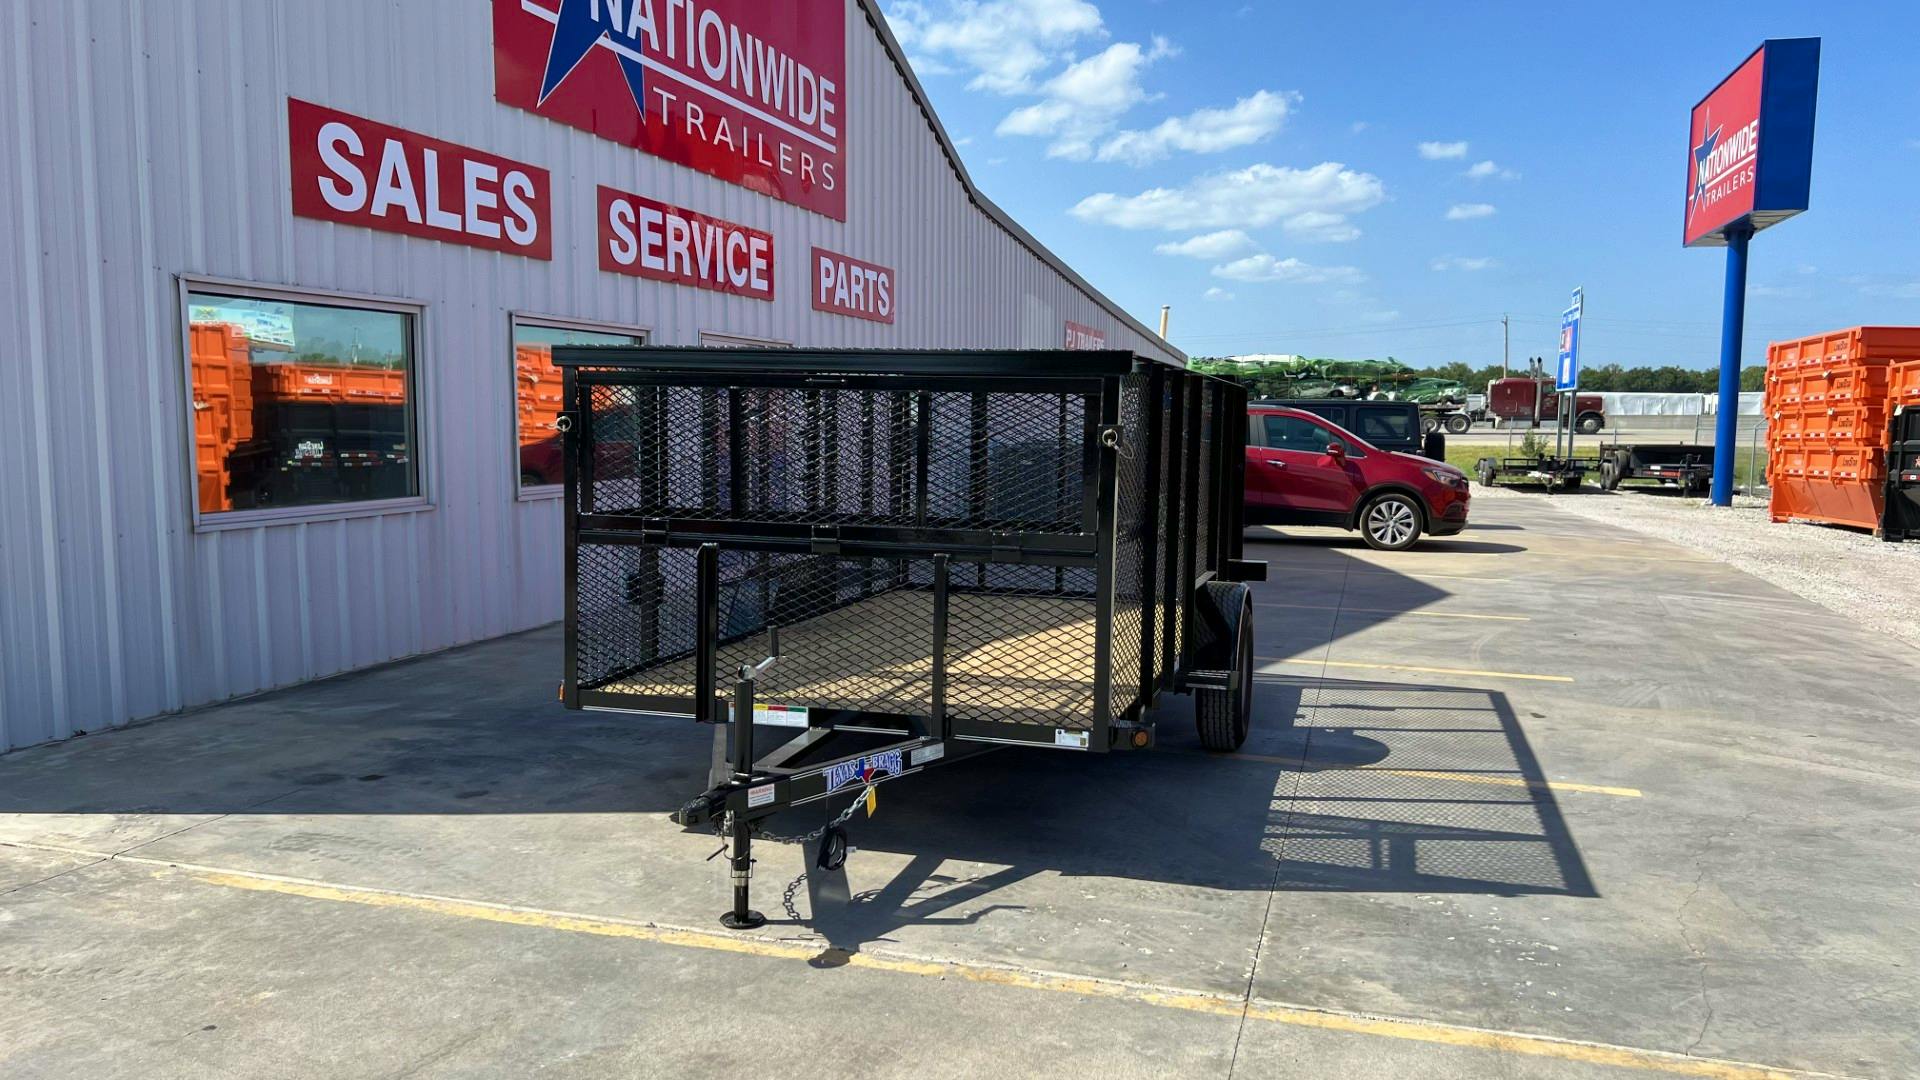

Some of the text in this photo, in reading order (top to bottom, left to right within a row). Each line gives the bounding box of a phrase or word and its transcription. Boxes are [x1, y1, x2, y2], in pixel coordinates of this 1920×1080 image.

[652, 86, 834, 191] TRAILERS
[1698, 118, 1758, 187] NATIONWIDE
[317, 122, 538, 246] SALES
[1706, 164, 1754, 208] TRAILERS
[609, 198, 769, 291] SERVICE
[819, 256, 890, 318] PARTS
[823, 760, 857, 794] TEXAS
[871, 748, 902, 777] BRAGG
